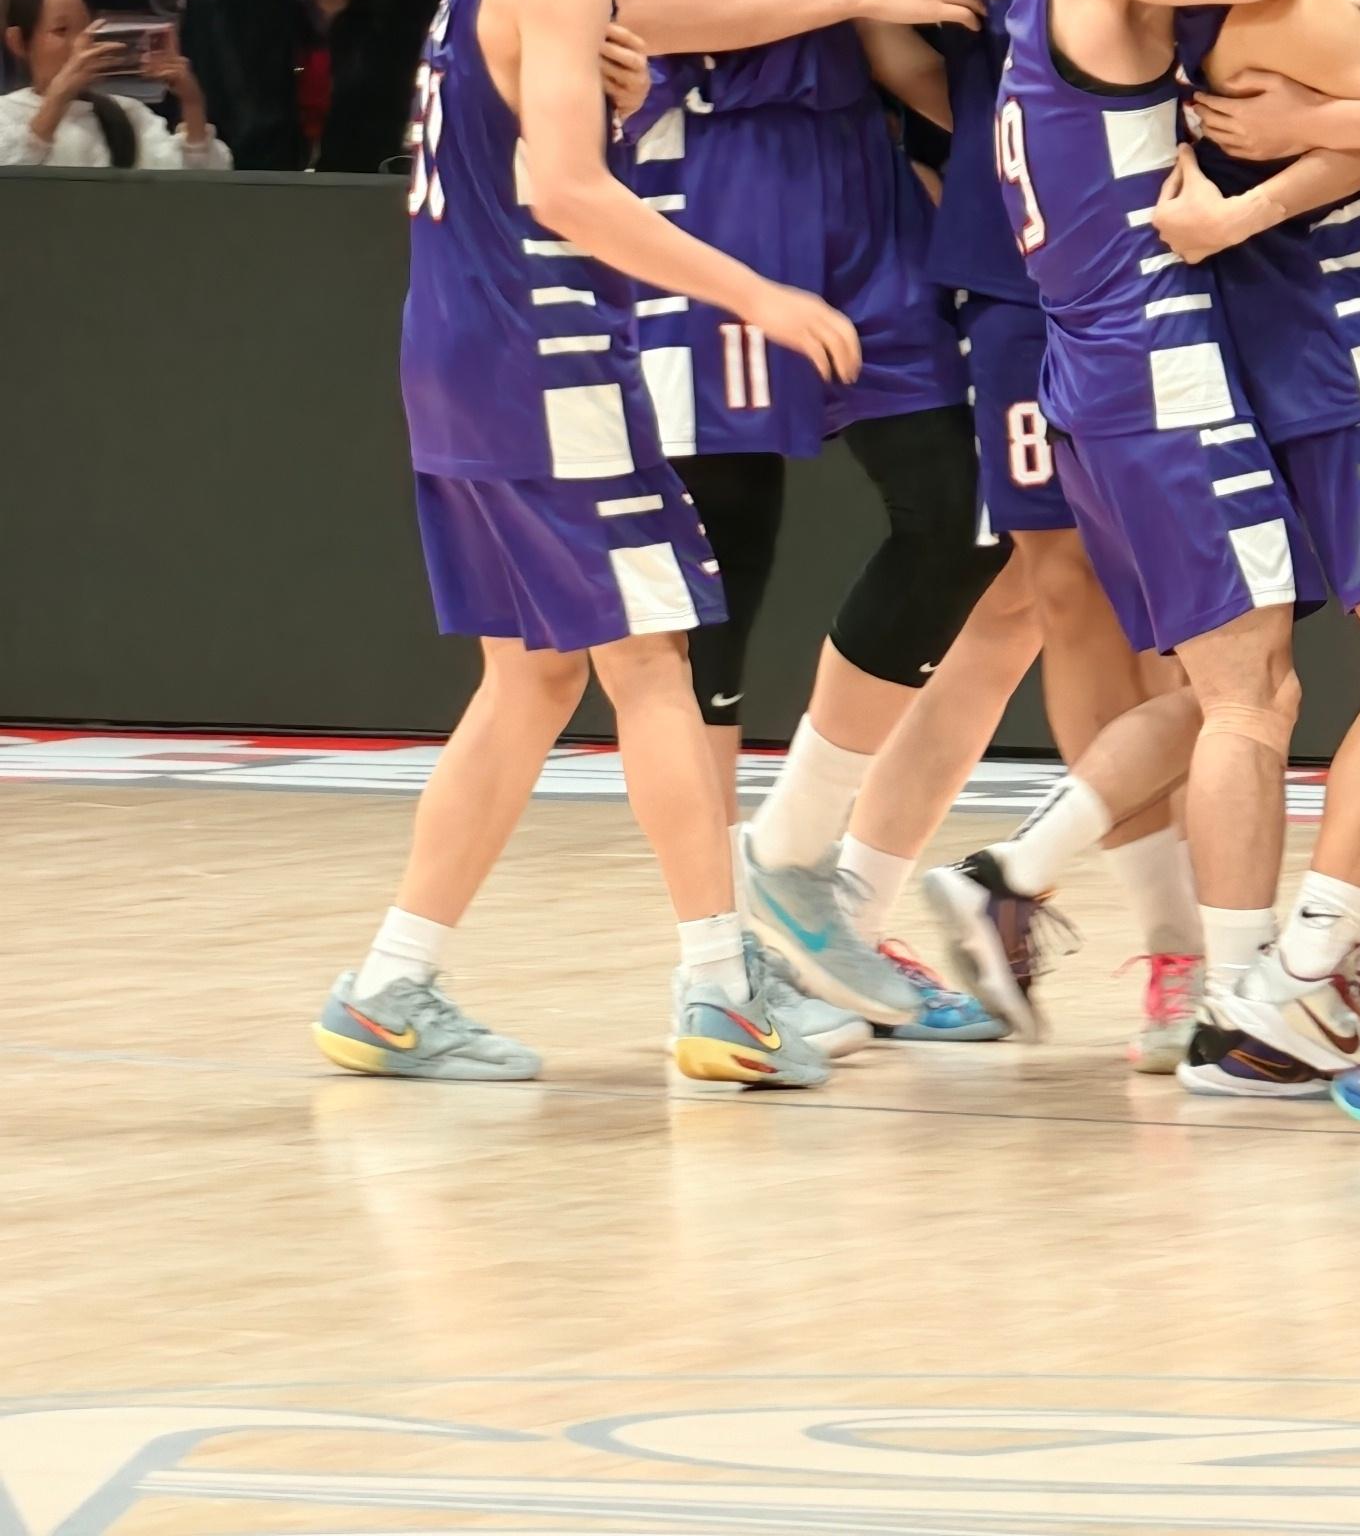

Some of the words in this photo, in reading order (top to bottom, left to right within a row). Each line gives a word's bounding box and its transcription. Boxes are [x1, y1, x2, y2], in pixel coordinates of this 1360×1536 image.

[994, 96, 1046, 254] 9
[718, 322, 772, 409] 11
[1007, 400, 1054, 487] 8
